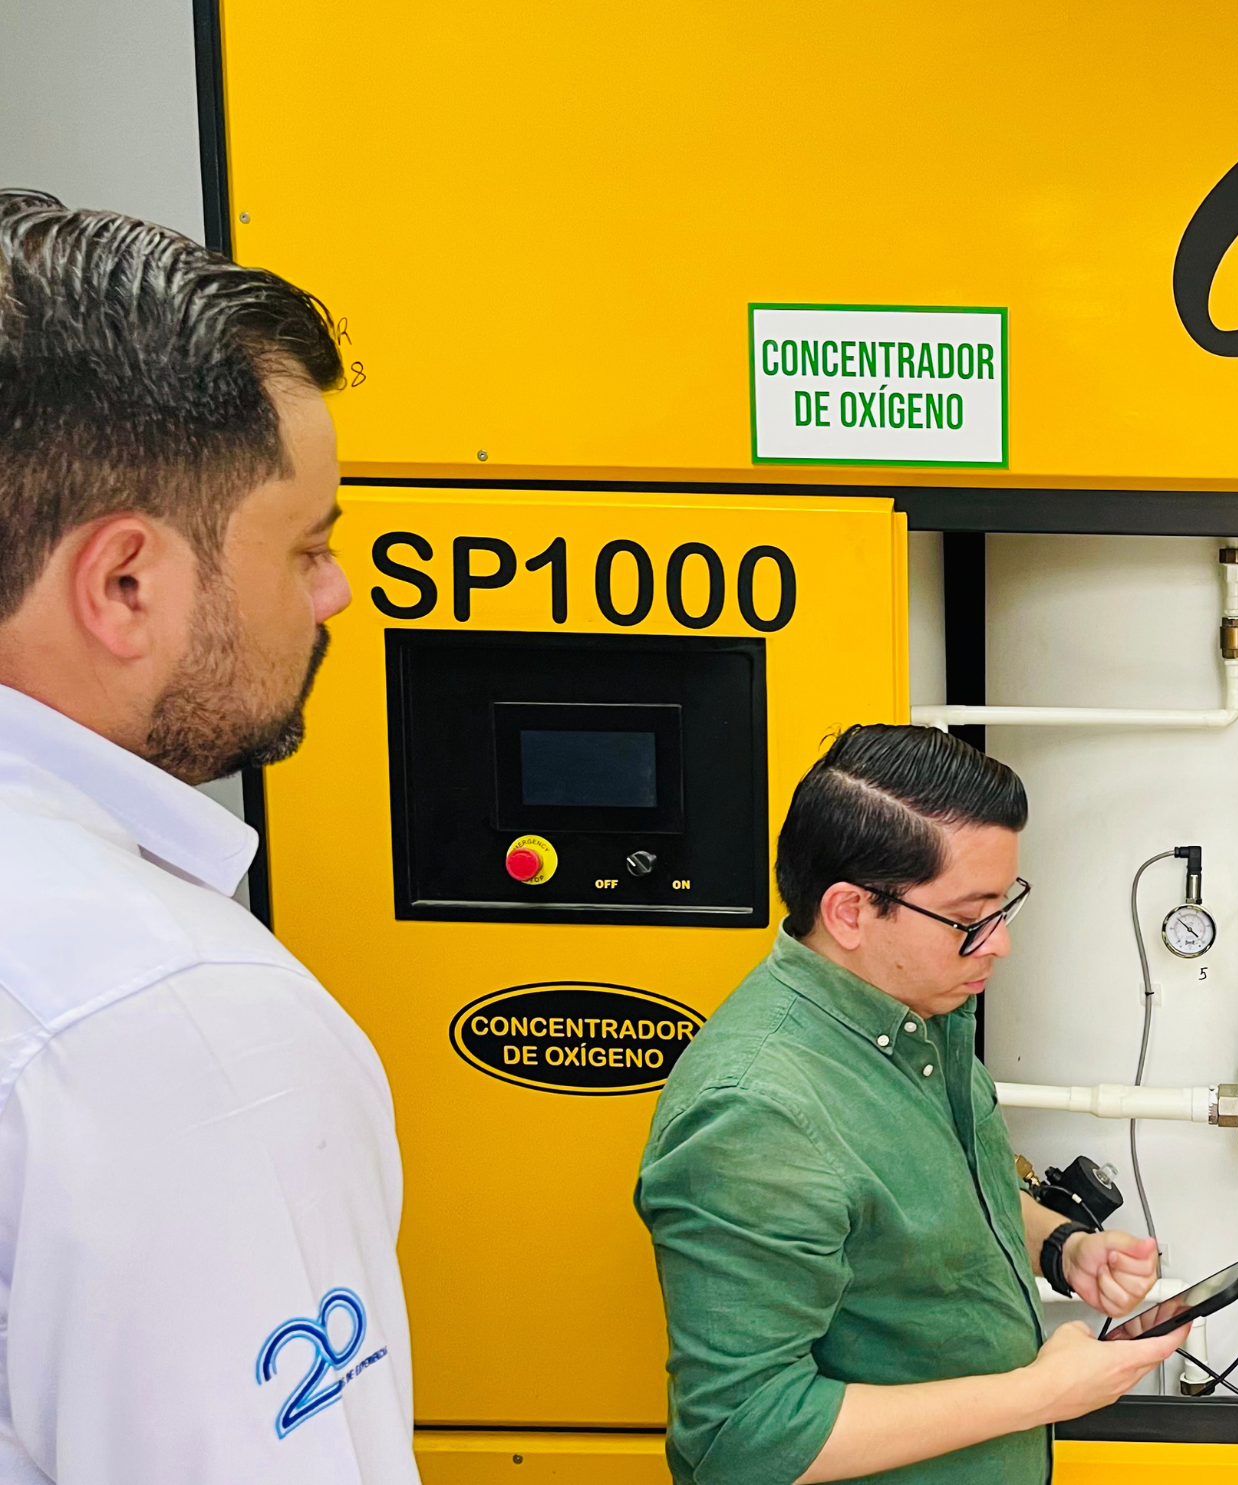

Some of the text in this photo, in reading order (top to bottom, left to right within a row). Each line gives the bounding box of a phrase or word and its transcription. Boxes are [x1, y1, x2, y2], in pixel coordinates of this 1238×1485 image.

[762, 339, 995, 380] CONCENTRADOR
[794, 384, 964, 430] DE OXÍGENO
[370, 531, 797, 632] SP1000
[513, 838, 550, 852] MERGENCY
[526, 875, 545, 883] TOP
[594, 879, 619, 890] OFF
[672, 879, 691, 890] ON
[1198, 966, 1208, 981] 5
[471, 1015, 694, 1041] CONCENTRADOR
[503, 1042, 664, 1069] DE OXÍGENO
[256, 1287, 367, 1440] 20
